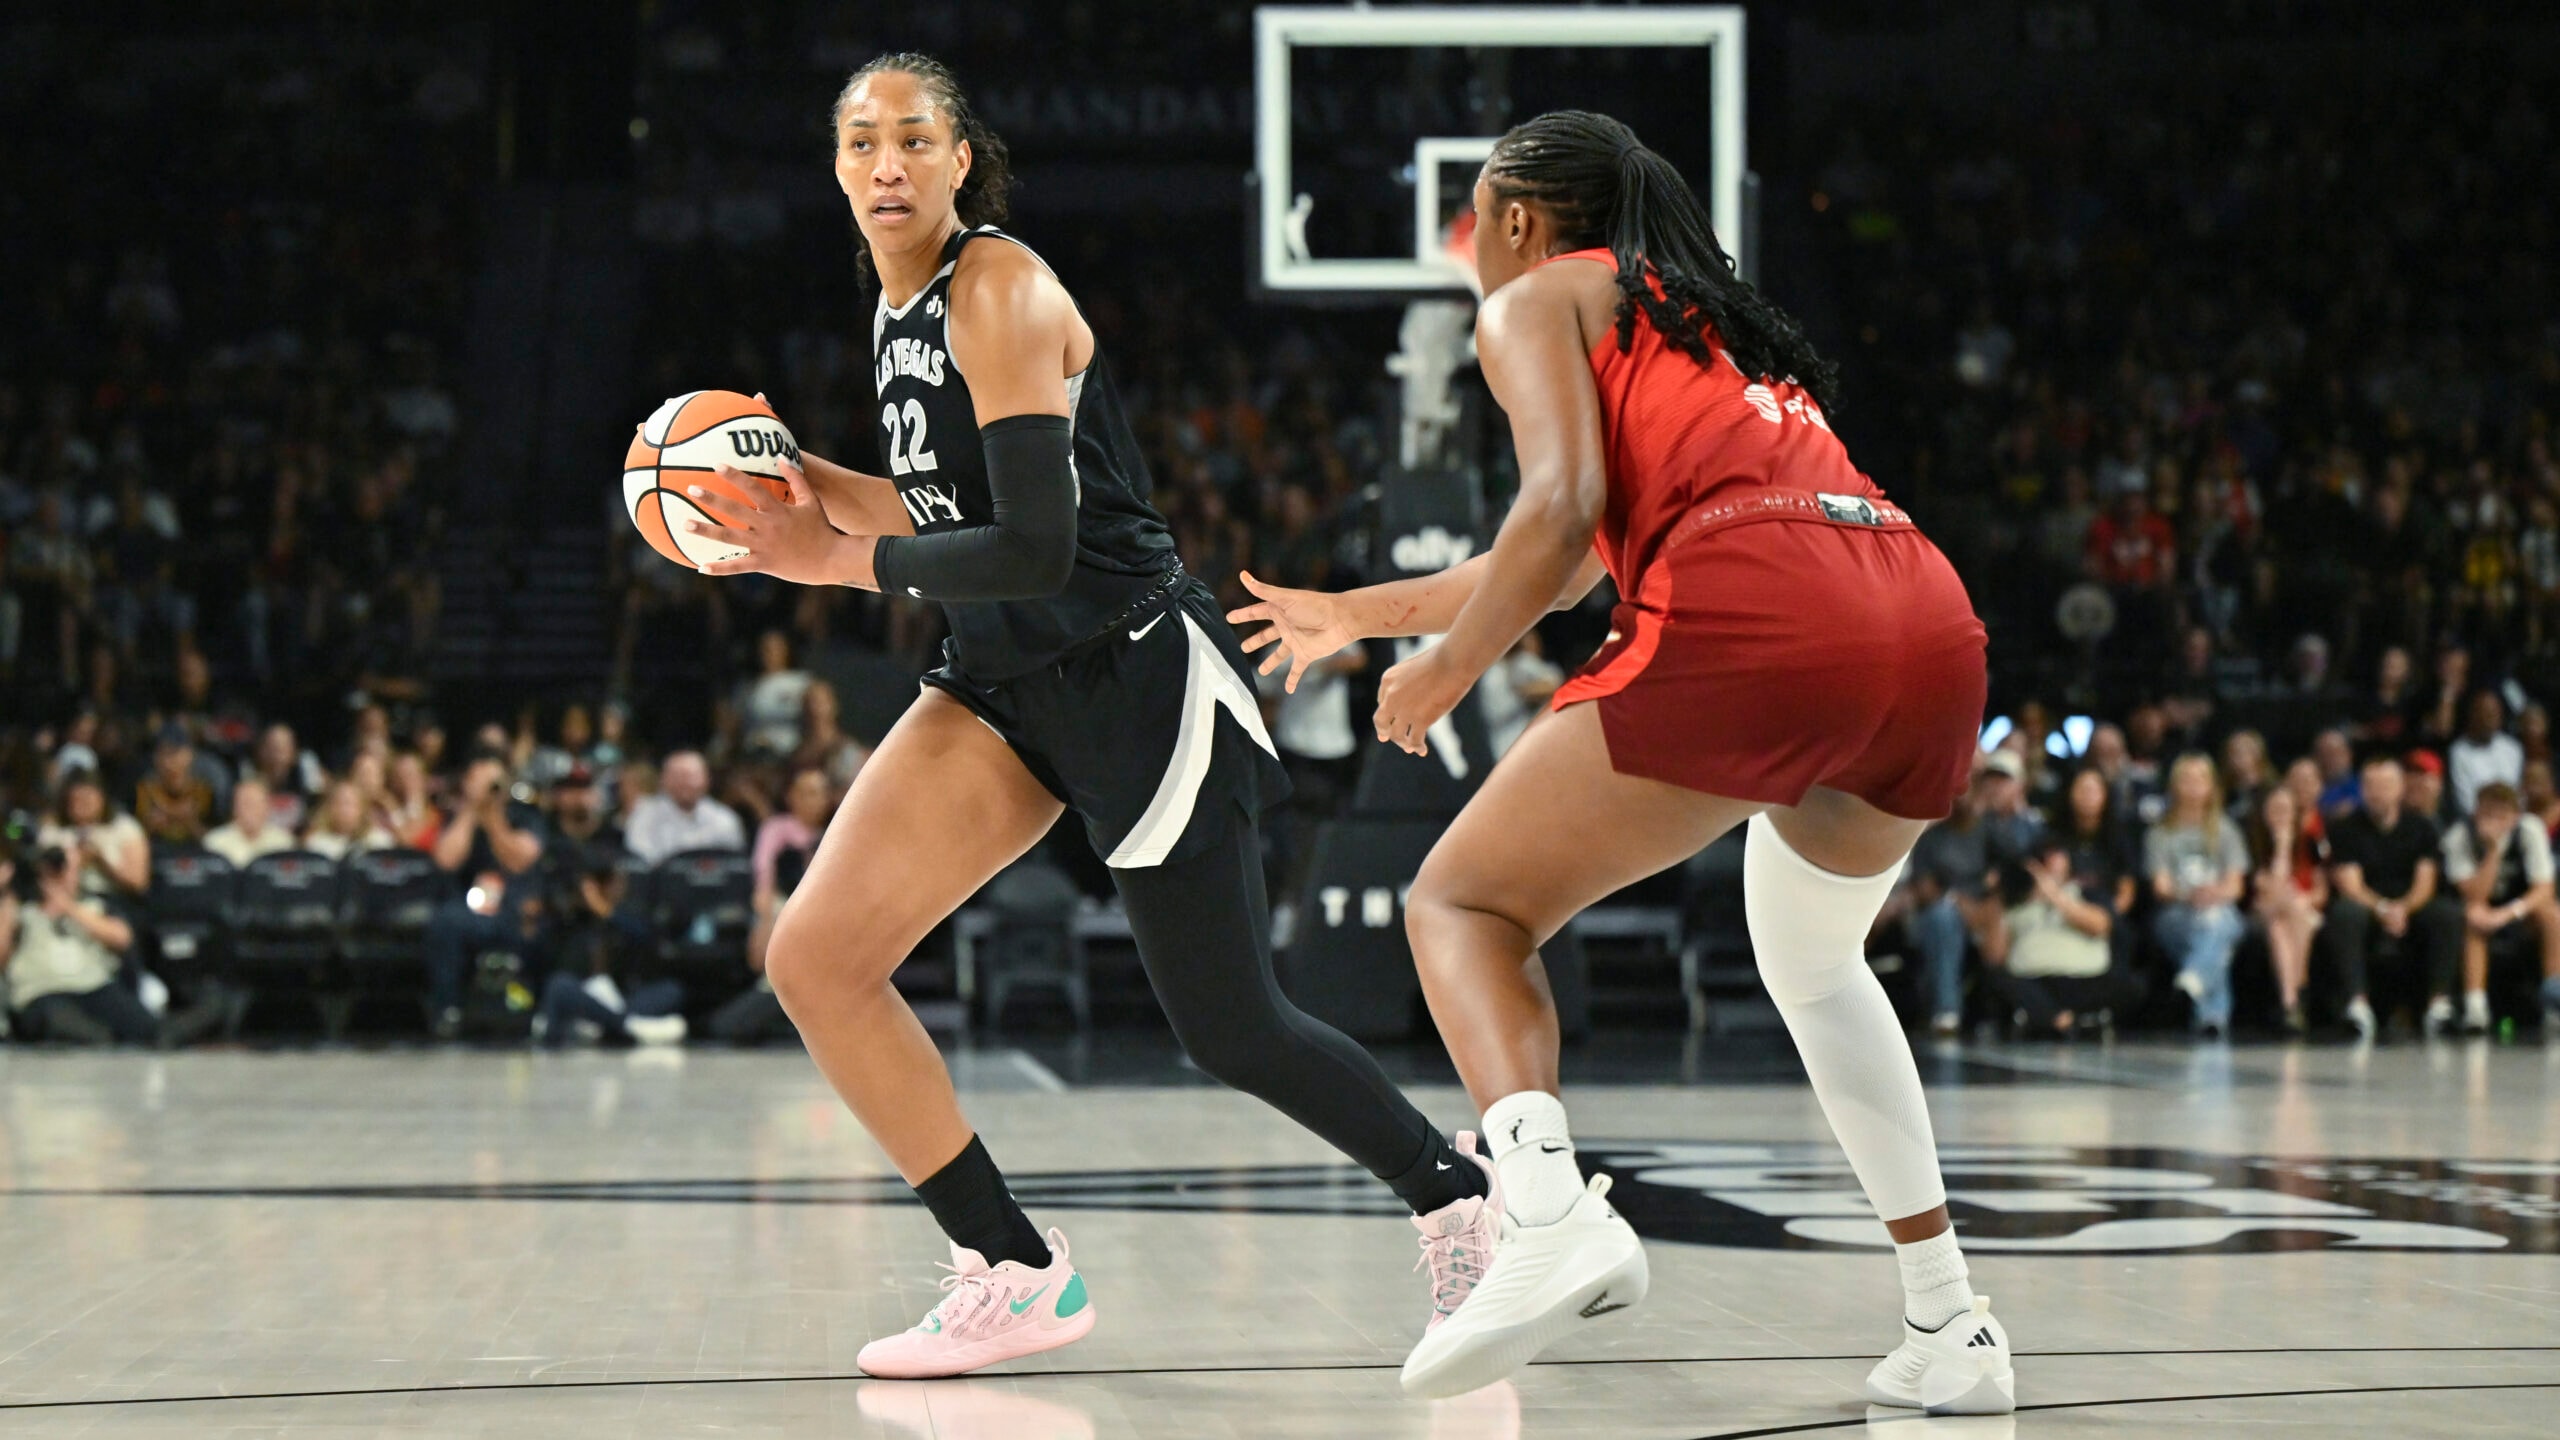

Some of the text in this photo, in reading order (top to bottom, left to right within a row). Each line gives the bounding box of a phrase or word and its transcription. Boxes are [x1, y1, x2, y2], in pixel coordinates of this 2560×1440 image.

[876, 338, 946, 400] LAS VEGAS
[882, 398, 938, 476] 22
